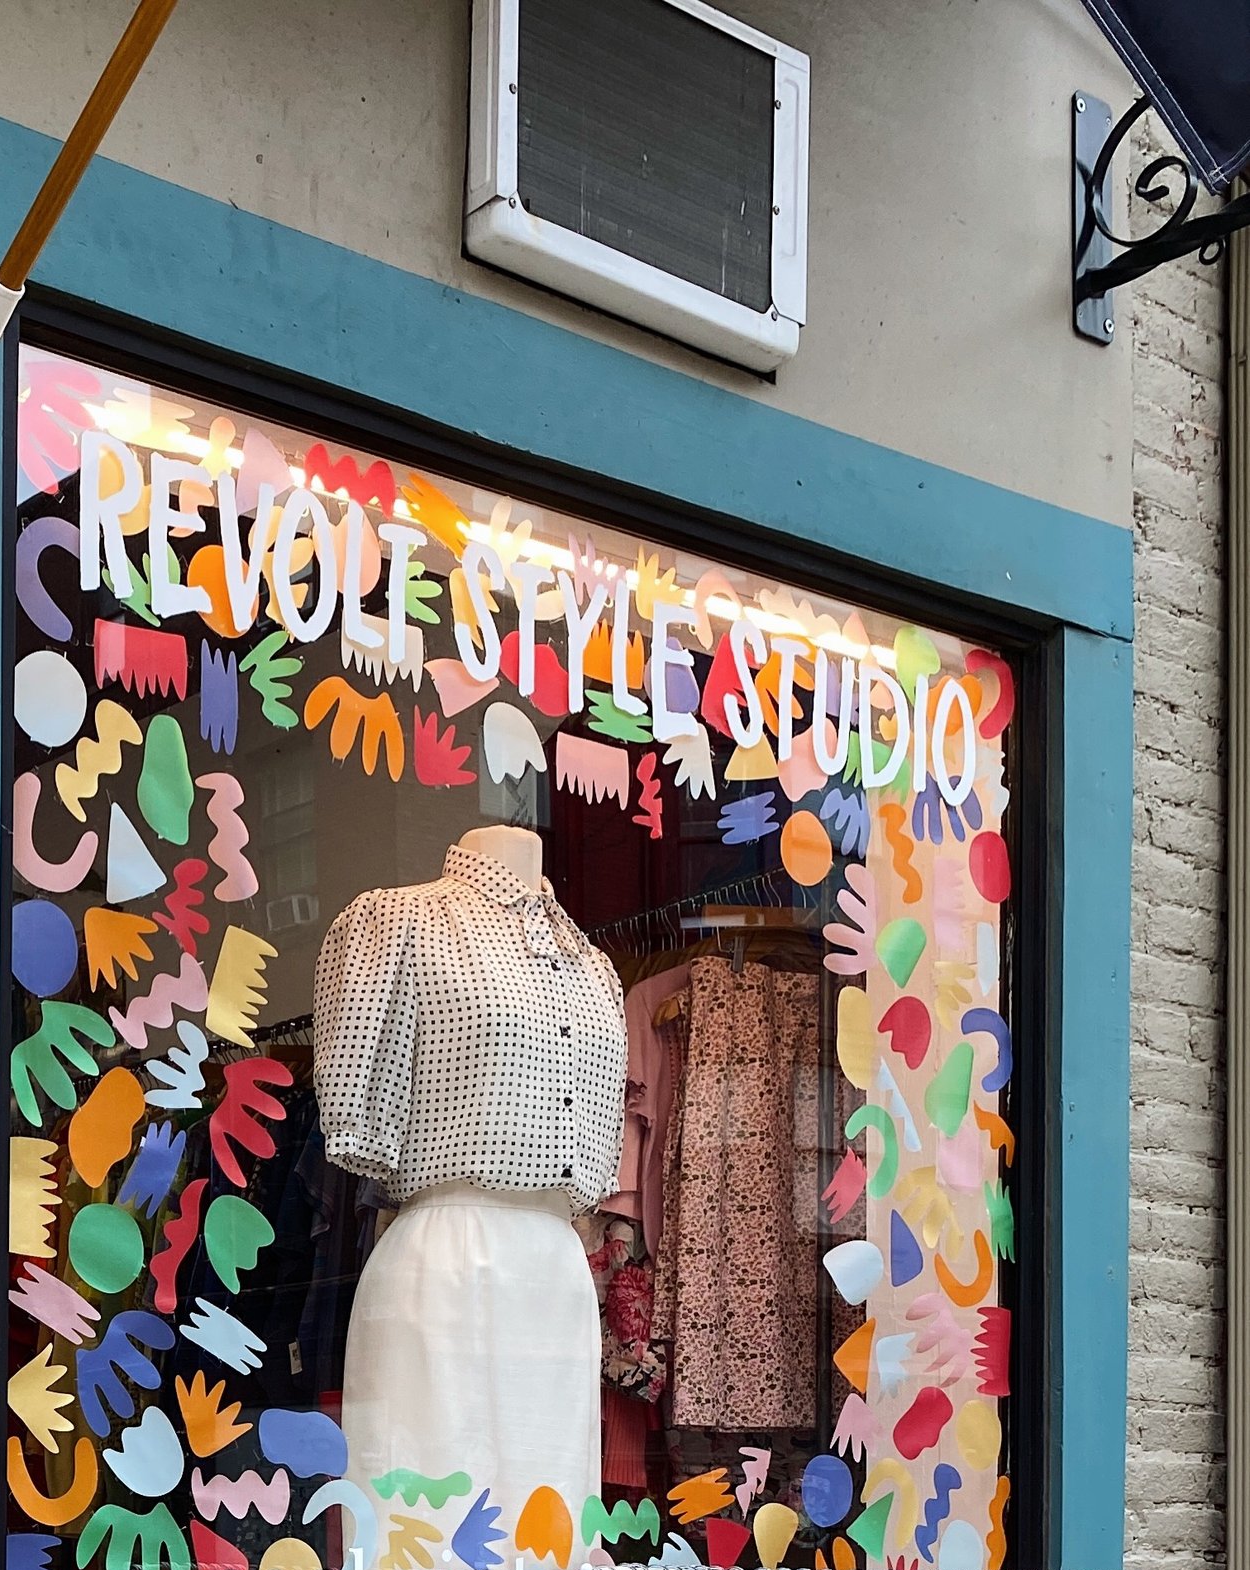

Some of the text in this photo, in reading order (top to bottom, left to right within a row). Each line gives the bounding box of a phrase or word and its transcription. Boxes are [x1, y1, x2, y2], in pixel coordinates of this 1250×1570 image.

[80, 431, 976, 806] REVOLT STYLE STUDIO
